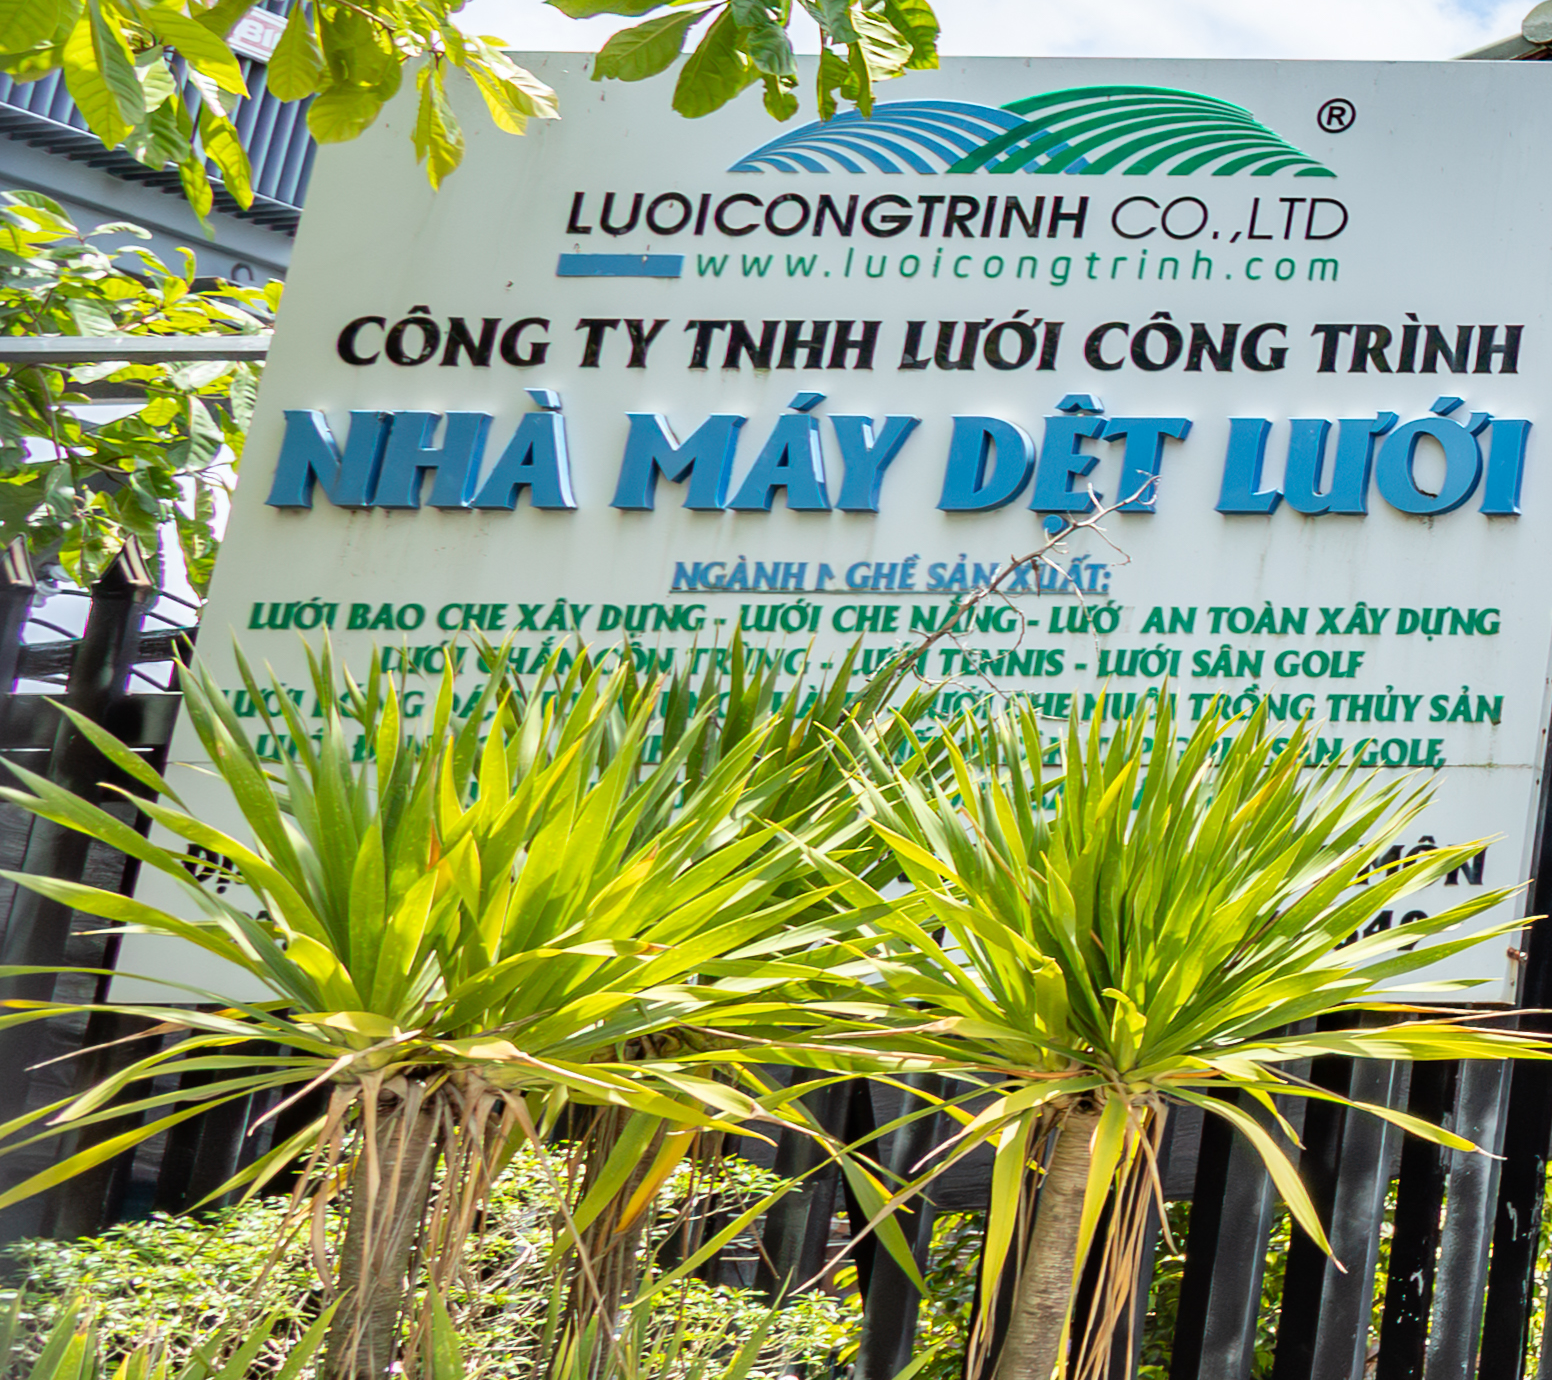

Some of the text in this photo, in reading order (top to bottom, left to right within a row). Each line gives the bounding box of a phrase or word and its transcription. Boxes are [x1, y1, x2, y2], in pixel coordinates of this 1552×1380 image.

[565, 191, 1349, 244] LUOICONGTRINH CO.,LTD
[696, 246, 1340, 287] www.luoicongtrinh.com
[336, 303, 1523, 376] CÔNG TY TNHH LƯỚI CÔNG TRÌNH
[266, 387, 1533, 536] NHÀ MÁY DỆT LƯỚI
[672, 555, 808, 591] NGÀNH
[247, 597, 340, 630] LƯỚI
[346, 602, 427, 630] BAO
[436, 602, 508, 631] CHE
[515, 598, 593, 632] XÂY
[597, 603, 707, 639] DỰNG
[741, 599, 822, 633] LƯỚI
[832, 604, 901, 633] CHE
[1140, 606, 1197, 634] AN
[1207, 601, 1308, 635] TOÀN
[1315, 602, 1390, 635] XÂY
[1396, 607, 1501, 642] DỰNG
[938, 648, 1066, 677] TENNIS
[1098, 643, 1182, 678] LƯỚI
[1191, 644, 1266, 678] SÂN
[1273, 650, 1367, 679] GOLF
[1327, 685, 1424, 722] THỦY
[1429, 686, 1504, 724] SẢN
